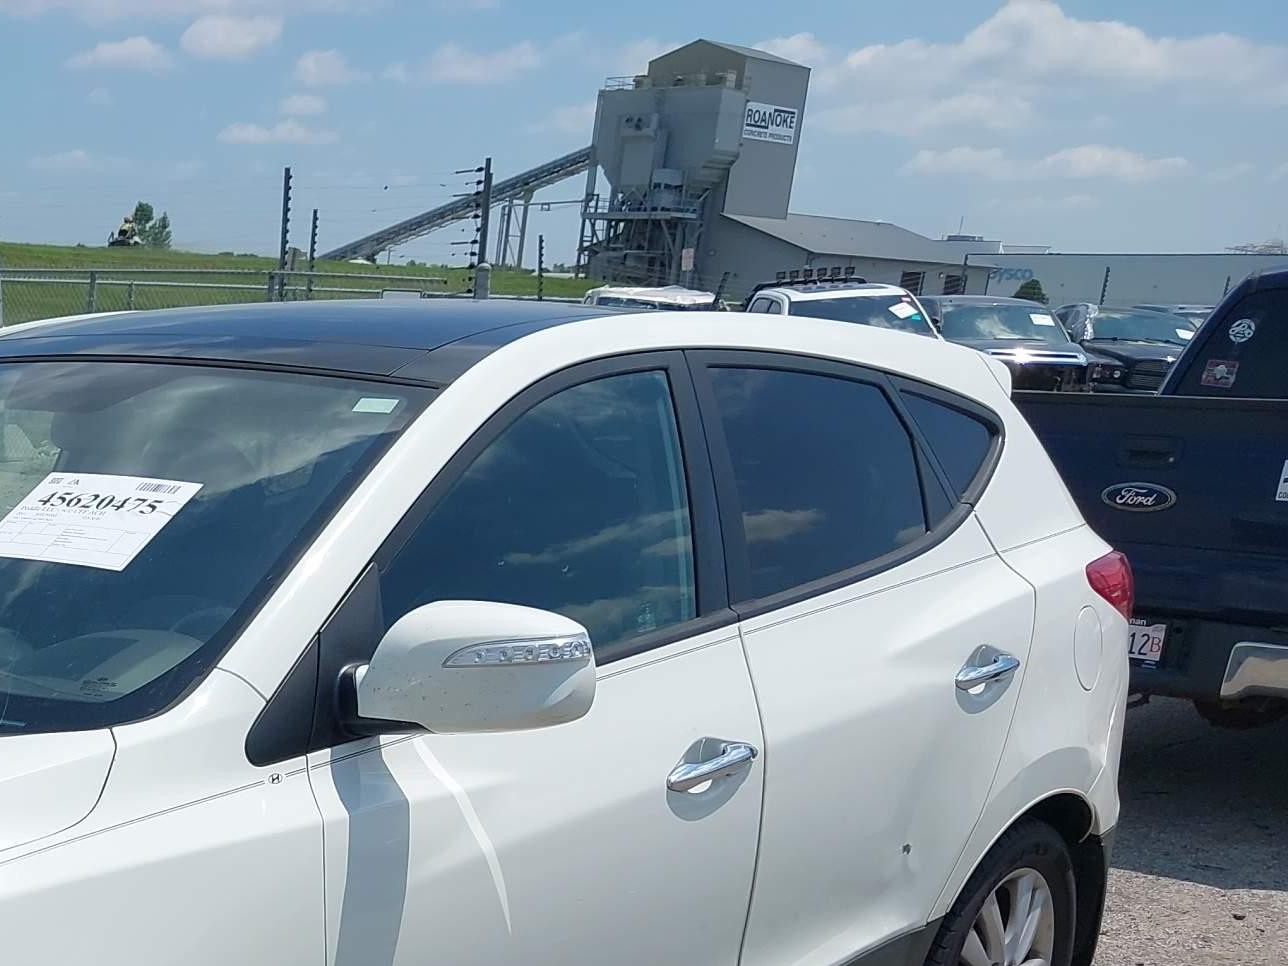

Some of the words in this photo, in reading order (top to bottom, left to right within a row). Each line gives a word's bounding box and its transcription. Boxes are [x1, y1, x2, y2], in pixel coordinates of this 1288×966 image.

[746, 108, 795, 129] ROANOKE
[38, 491, 162, 514] 45620475
[1116, 488, 1157, 505] Ford
